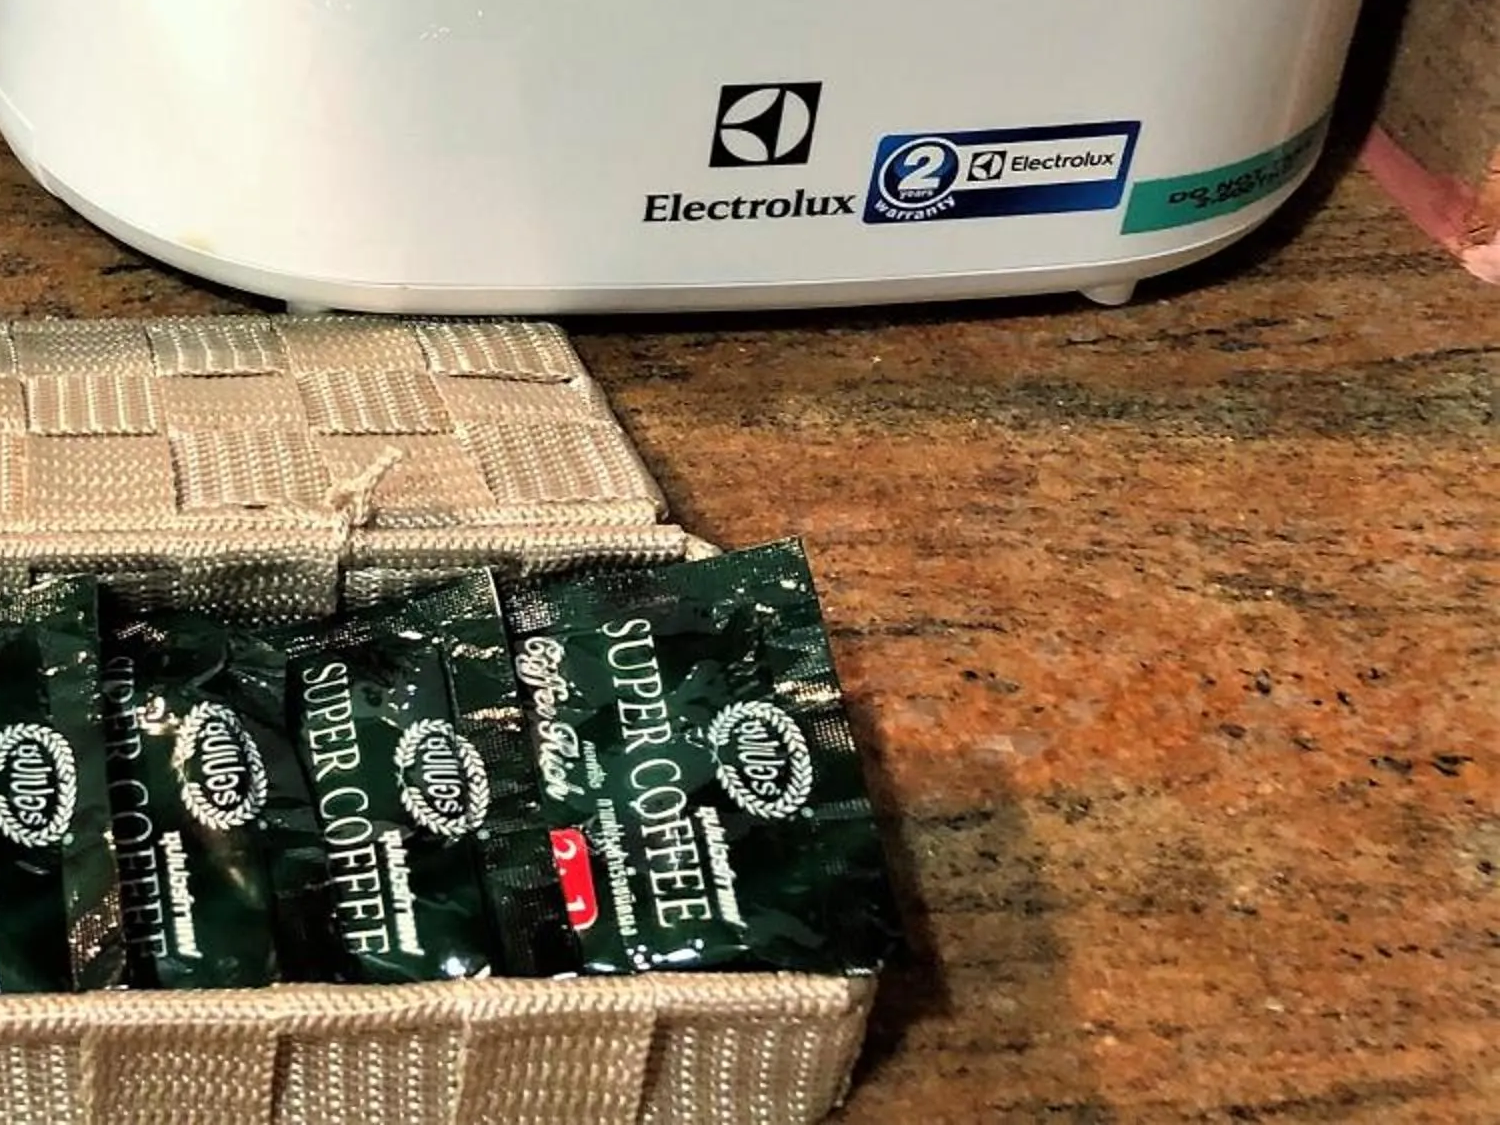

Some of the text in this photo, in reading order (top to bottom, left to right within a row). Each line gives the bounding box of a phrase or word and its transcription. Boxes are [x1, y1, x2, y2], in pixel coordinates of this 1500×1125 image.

[898, 145, 945, 190] 2
[1011, 150, 1117, 172] Electrolux
[643, 188, 857, 223] Electrolux
[874, 194, 956, 222] warranty
[899, 188, 934, 200] years
[535, 721, 584, 802] Rich
[600, 618, 712, 930] SUPER COFFEE
[300, 662, 389, 956] SUPER COFFEE
